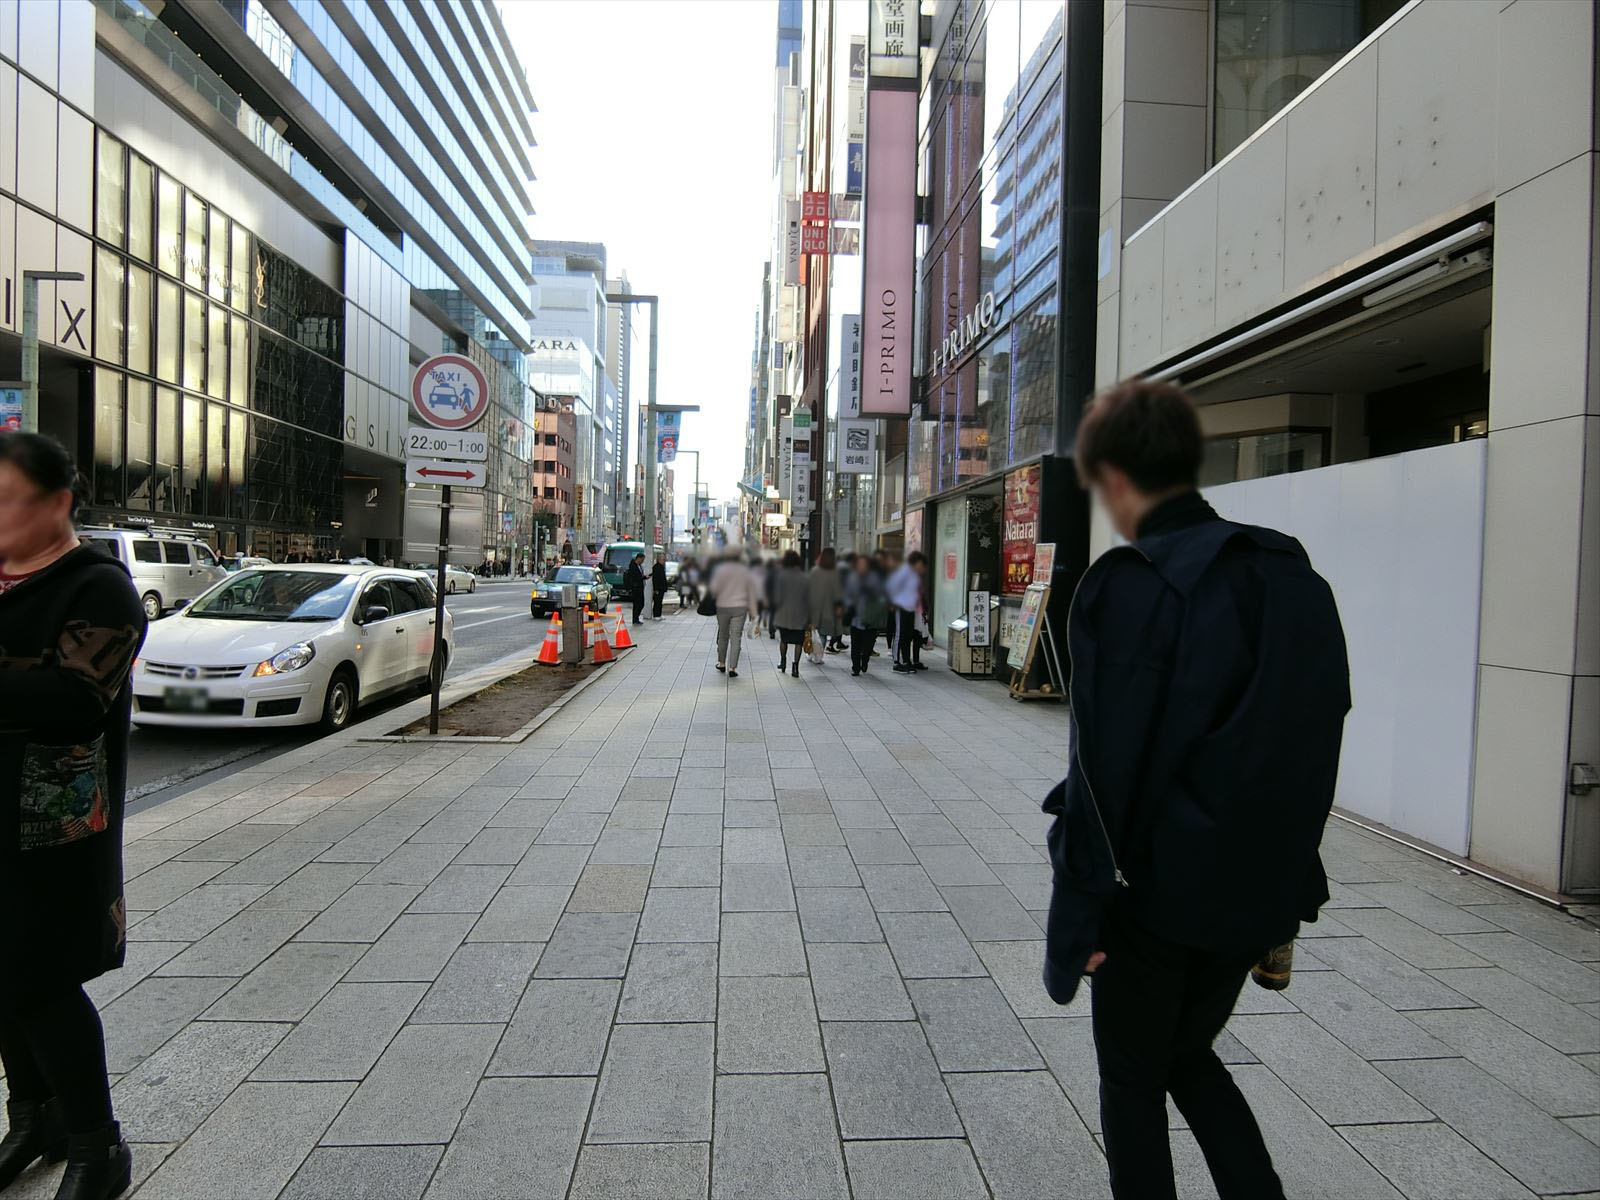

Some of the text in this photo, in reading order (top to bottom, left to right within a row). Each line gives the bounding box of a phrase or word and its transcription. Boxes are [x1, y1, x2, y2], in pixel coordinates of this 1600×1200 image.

[788, 228, 799, 264] DIANA
[804, 229, 824, 239] UNI
[804, 240, 825, 251] QLO
[880, 289, 896, 394] I-PRIMO
[932, 291, 996, 376] I-PRIMO
[431, 370, 461, 383] TAXI
[1005, 512, 1037, 544] Nataraj
